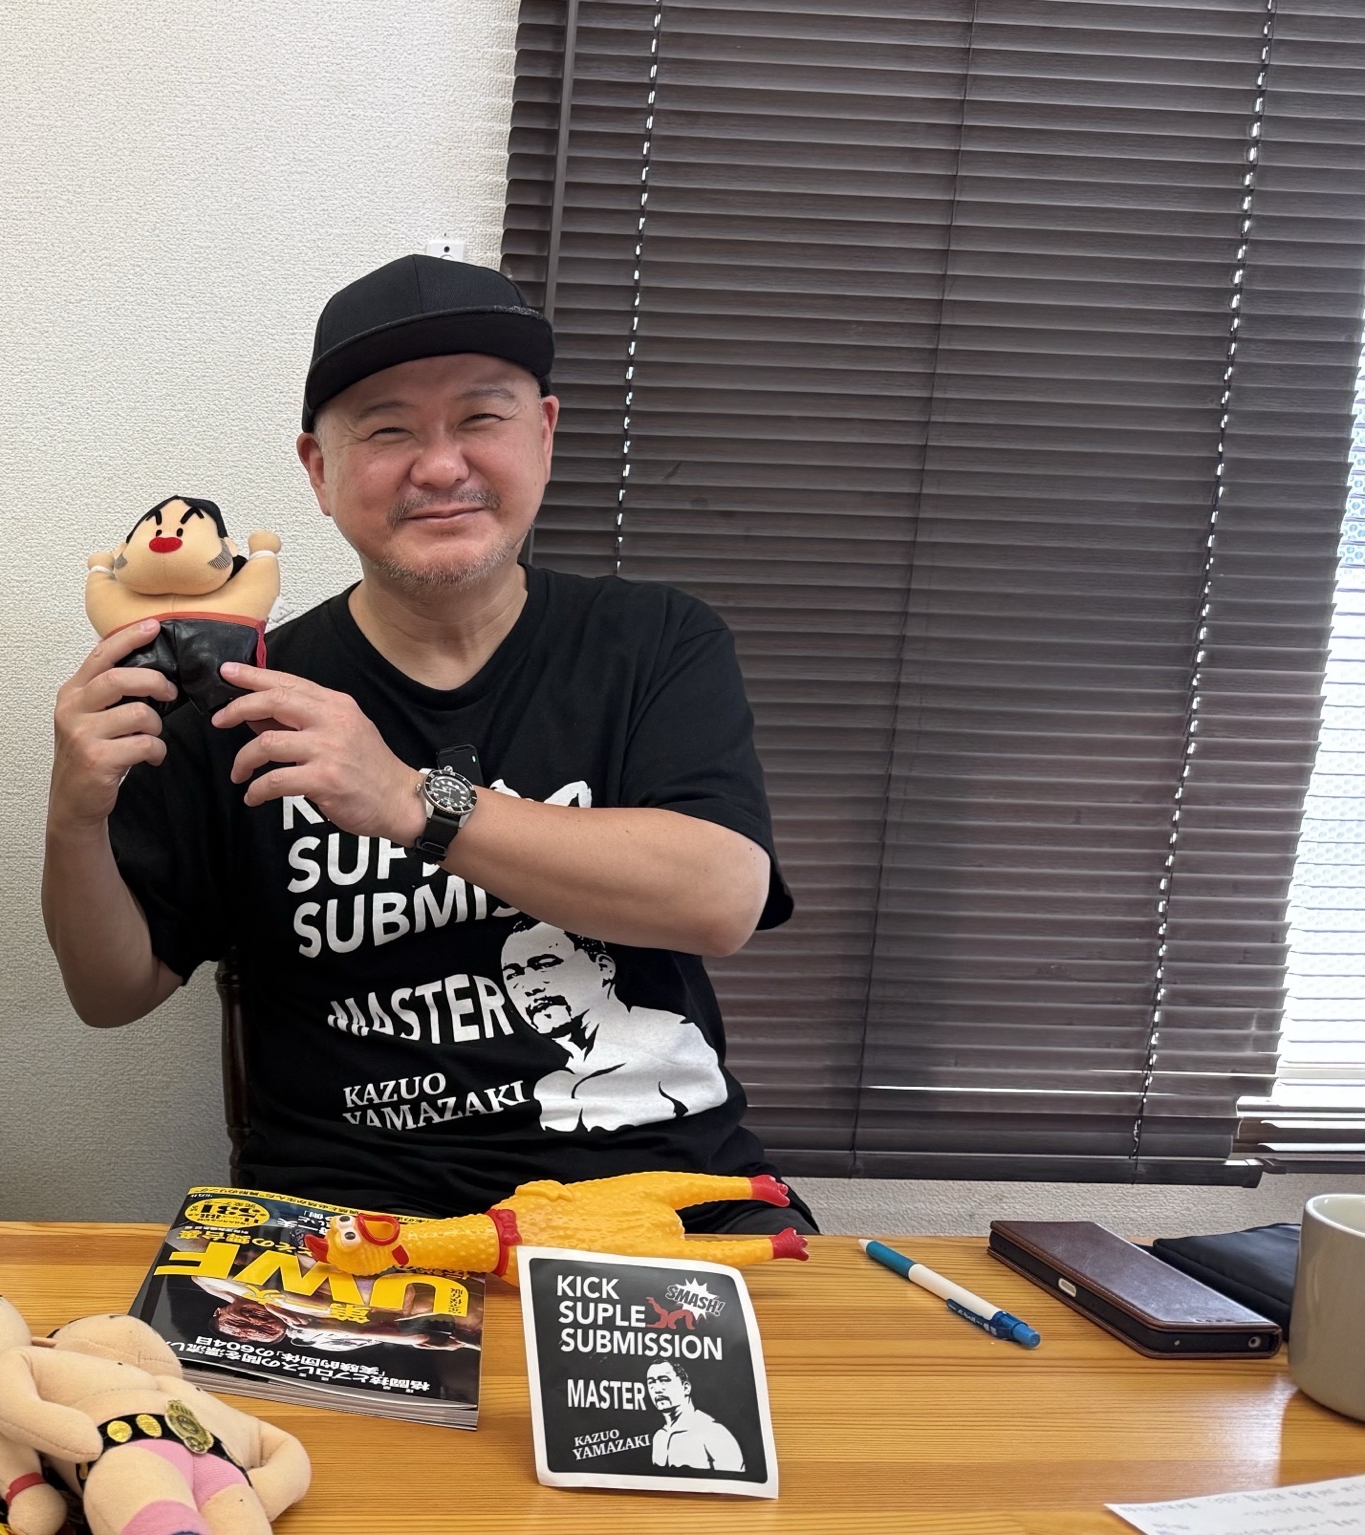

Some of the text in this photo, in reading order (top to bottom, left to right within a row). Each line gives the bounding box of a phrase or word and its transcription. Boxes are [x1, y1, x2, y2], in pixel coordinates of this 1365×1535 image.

[327, 973, 515, 1045] MASTER
[343, 1072, 447, 1108] KAZUO
[343, 1080, 531, 1131] YAMAZAKI
[153, 1242, 470, 1318] UWF
[556, 1274, 620, 1300] KICK
[664, 1284, 726, 1317] SMASH!
[560, 1328, 723, 1361] SUBMISSION
[167, 1339, 431, 1392] 格闘技とプロレスの間を漂流し
[567, 1378, 647, 1411] MASTER
[572, 1433, 651, 1460] YAMAZAKI
[573, 1429, 620, 1447] KAZUO
